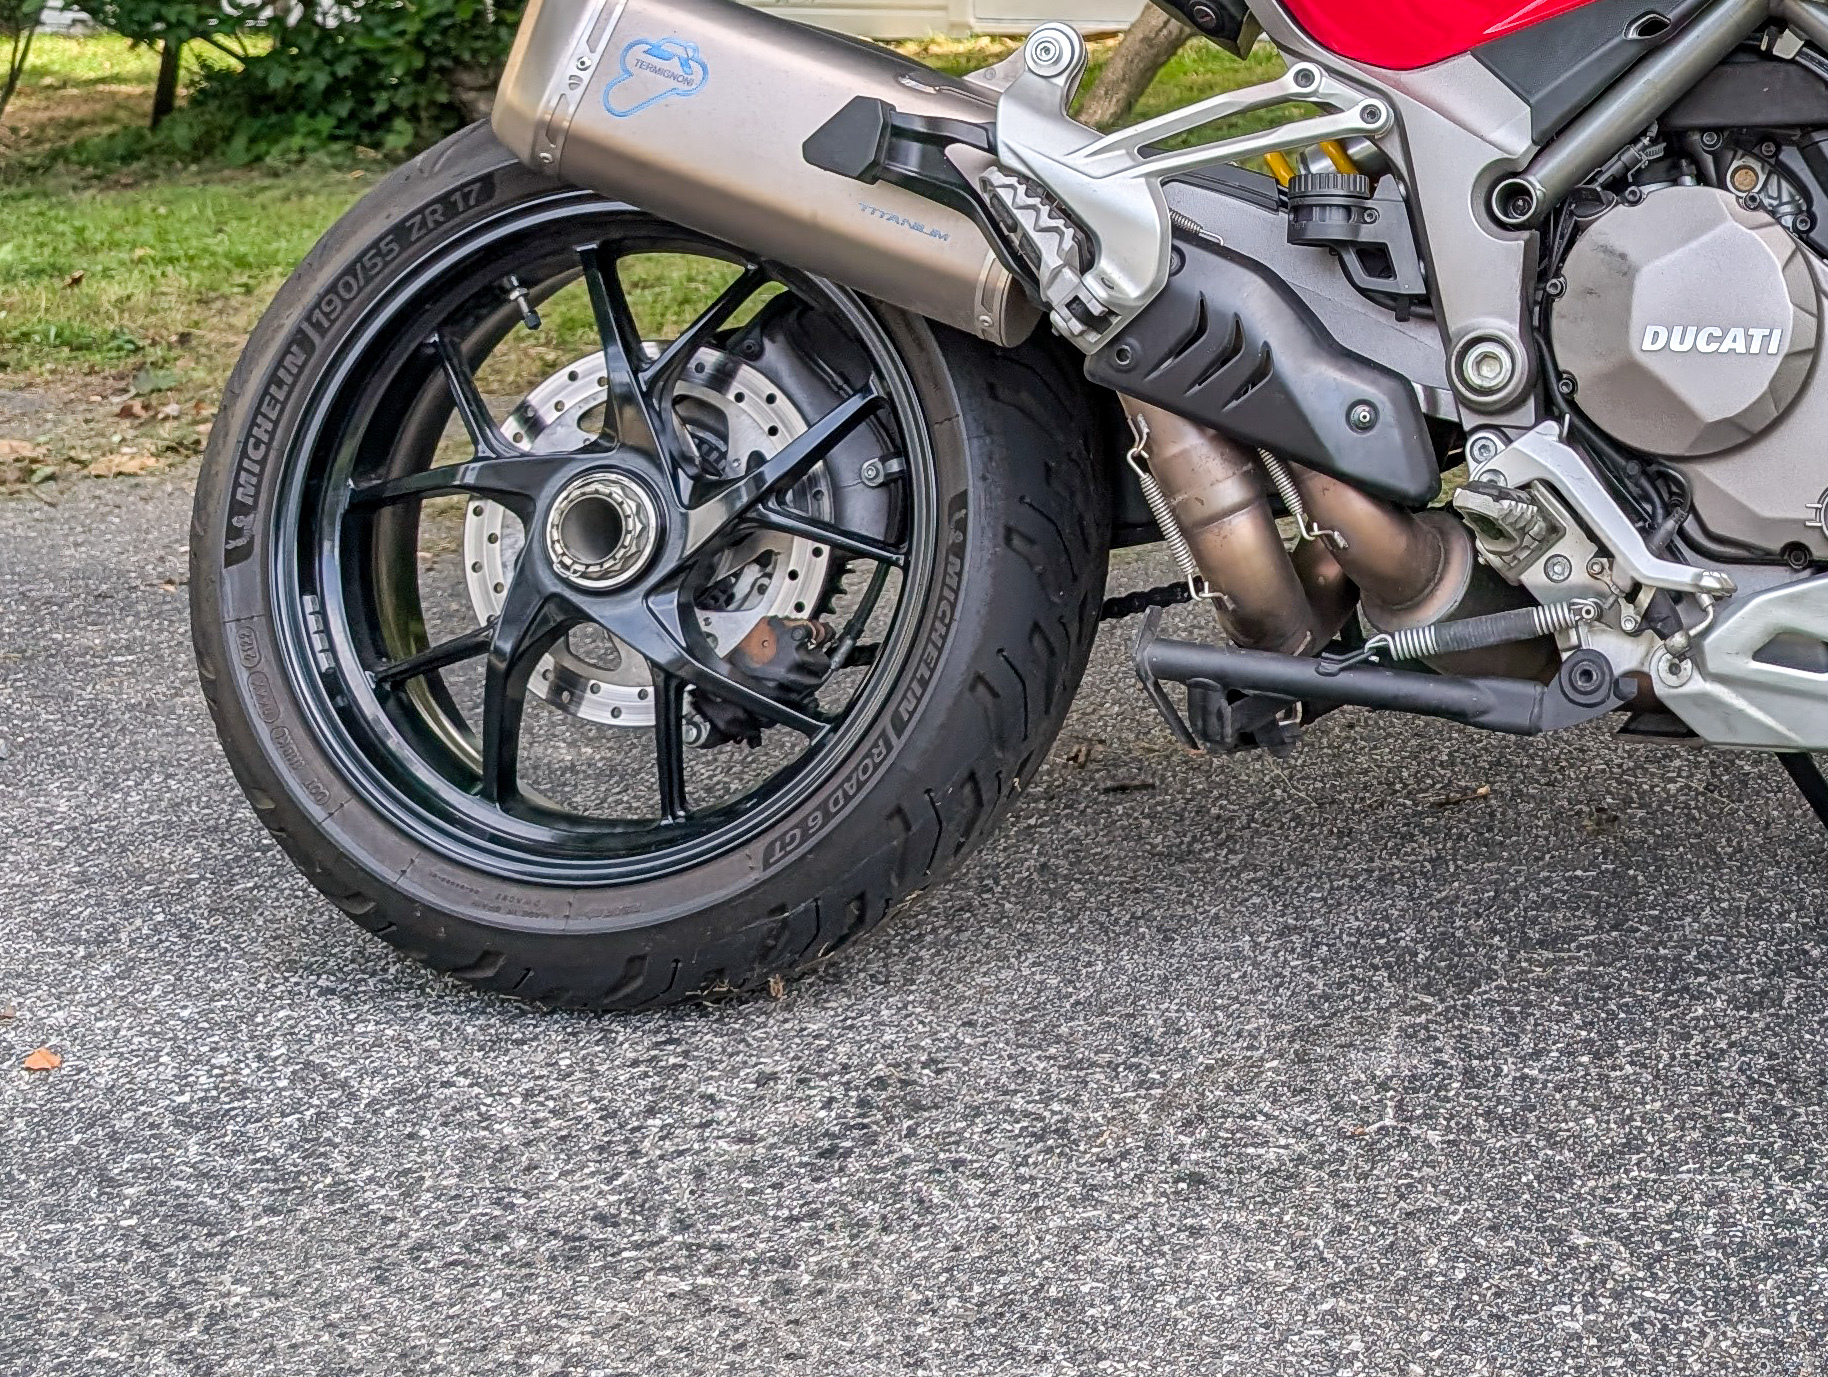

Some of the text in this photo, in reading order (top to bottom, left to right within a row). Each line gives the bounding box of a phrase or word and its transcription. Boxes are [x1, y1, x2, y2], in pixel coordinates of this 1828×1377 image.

[634, 58, 694, 87] TERMIGNONI
[236, 184, 484, 506] MICHELIN 190/55 ZR 17
[1641, 325, 1783, 355] DUCATI
[770, 556, 962, 861] MICHELIN ROAD 6 GT
